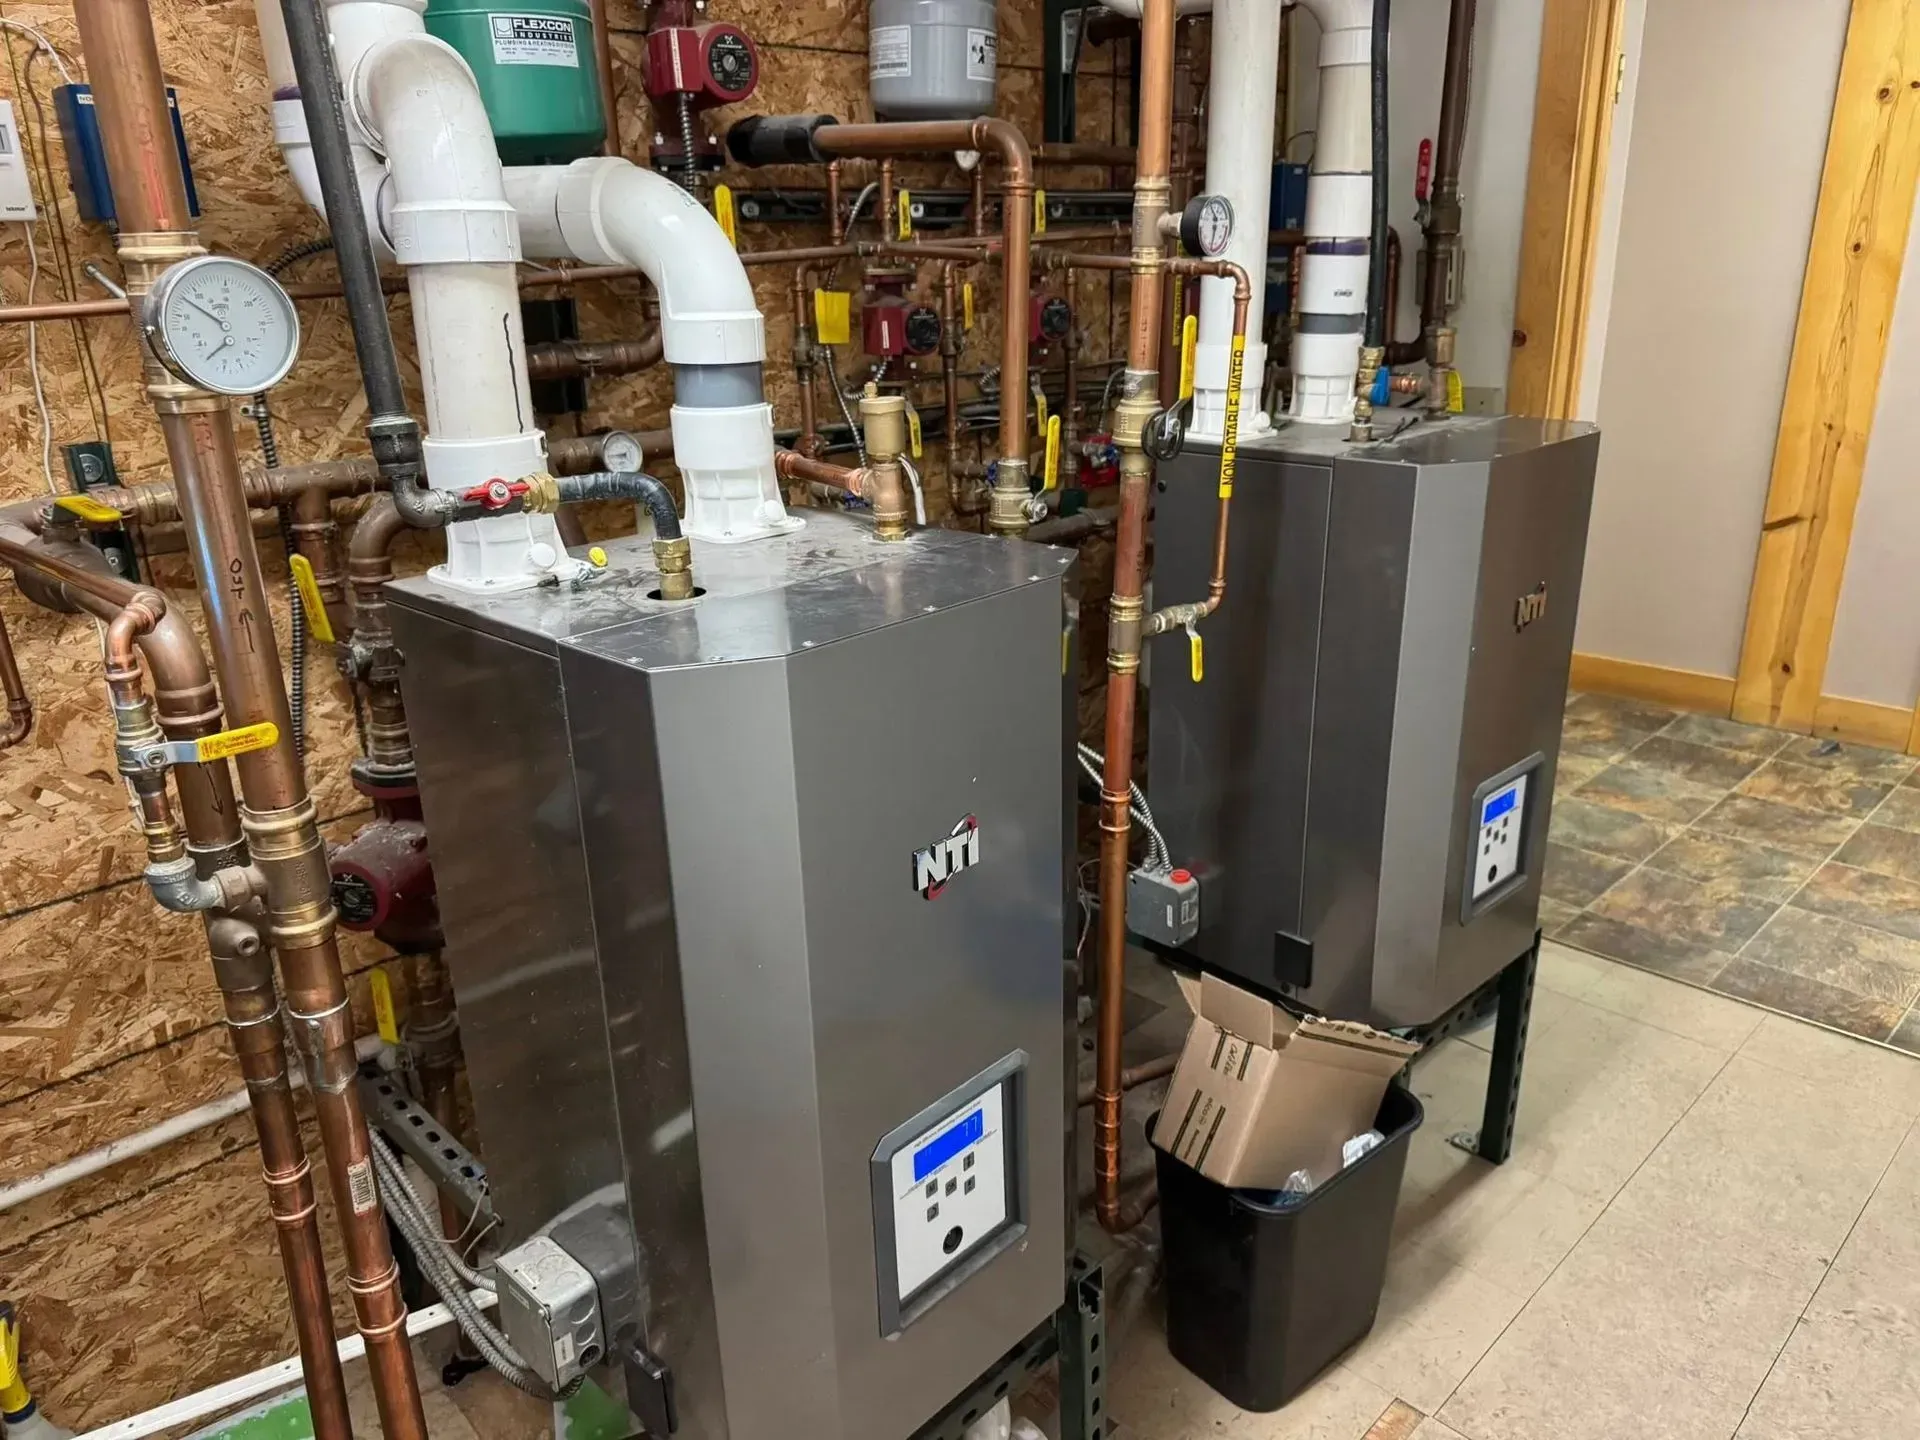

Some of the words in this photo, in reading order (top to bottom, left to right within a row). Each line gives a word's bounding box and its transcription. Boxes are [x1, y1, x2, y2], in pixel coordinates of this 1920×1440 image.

[513, 19, 571, 32] FLEXCON
[514, 32, 573, 41] INDUSTRIES
[1230, 350, 1244, 393] WATER
[1224, 400, 1240, 454] POTABLE
[1222, 460, 1236, 486] NON
[914, 826, 979, 891] NTI
